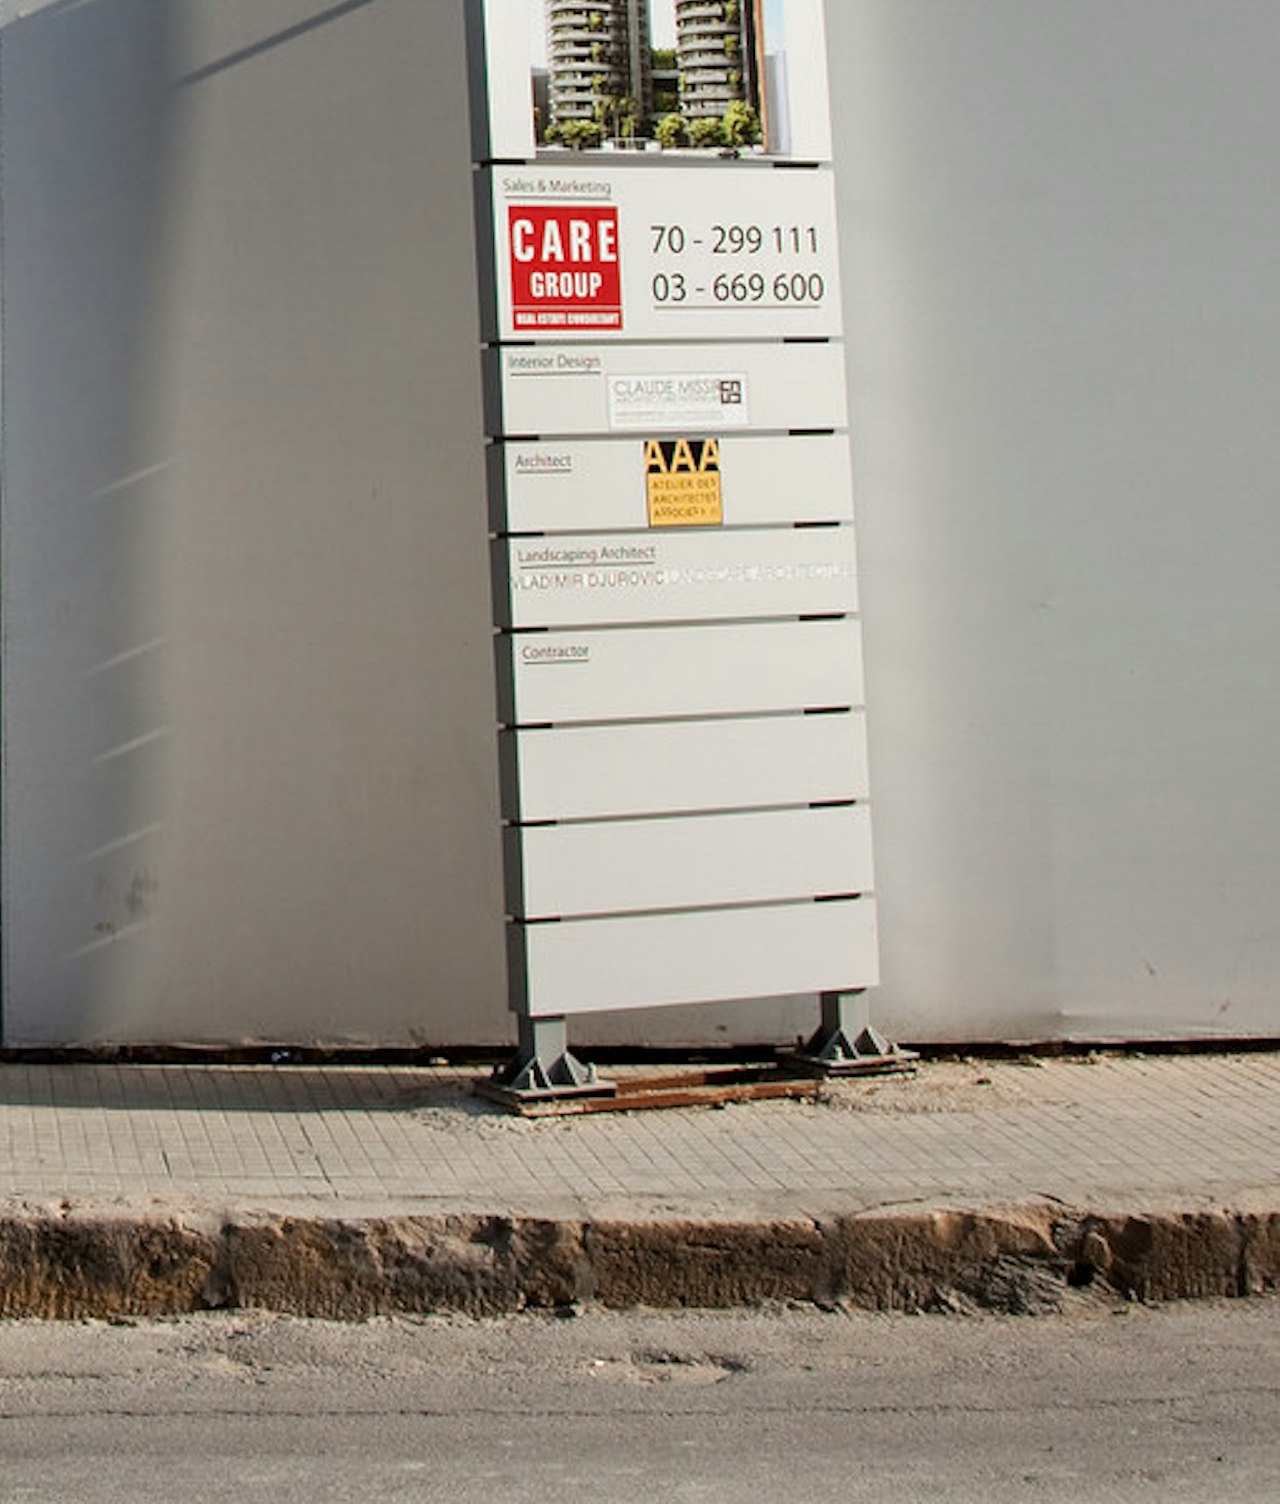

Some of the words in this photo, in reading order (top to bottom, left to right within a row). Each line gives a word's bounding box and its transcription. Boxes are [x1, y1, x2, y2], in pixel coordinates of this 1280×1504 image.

[503, 178, 534, 193] Sales
[538, 179, 546, 193] &
[549, 179, 612, 196] Marketing
[512, 218, 618, 263] CARE
[650, 226, 685, 254] 70
[712, 226, 762, 254] 299
[773, 226, 819, 253] 111
[530, 271, 603, 298] GROUP
[652, 274, 687, 301] 03
[713, 274, 765, 301] 669
[773, 274, 824, 301] 600
[508, 354, 554, 369] Interior
[557, 353, 601, 371] Design
[515, 453, 572, 467] Architect
[645, 439, 720, 473] AAA
[517, 547, 598, 564] Landscaping
[600, 546, 656, 559] Architect
[522, 646, 589, 659] Contractor
